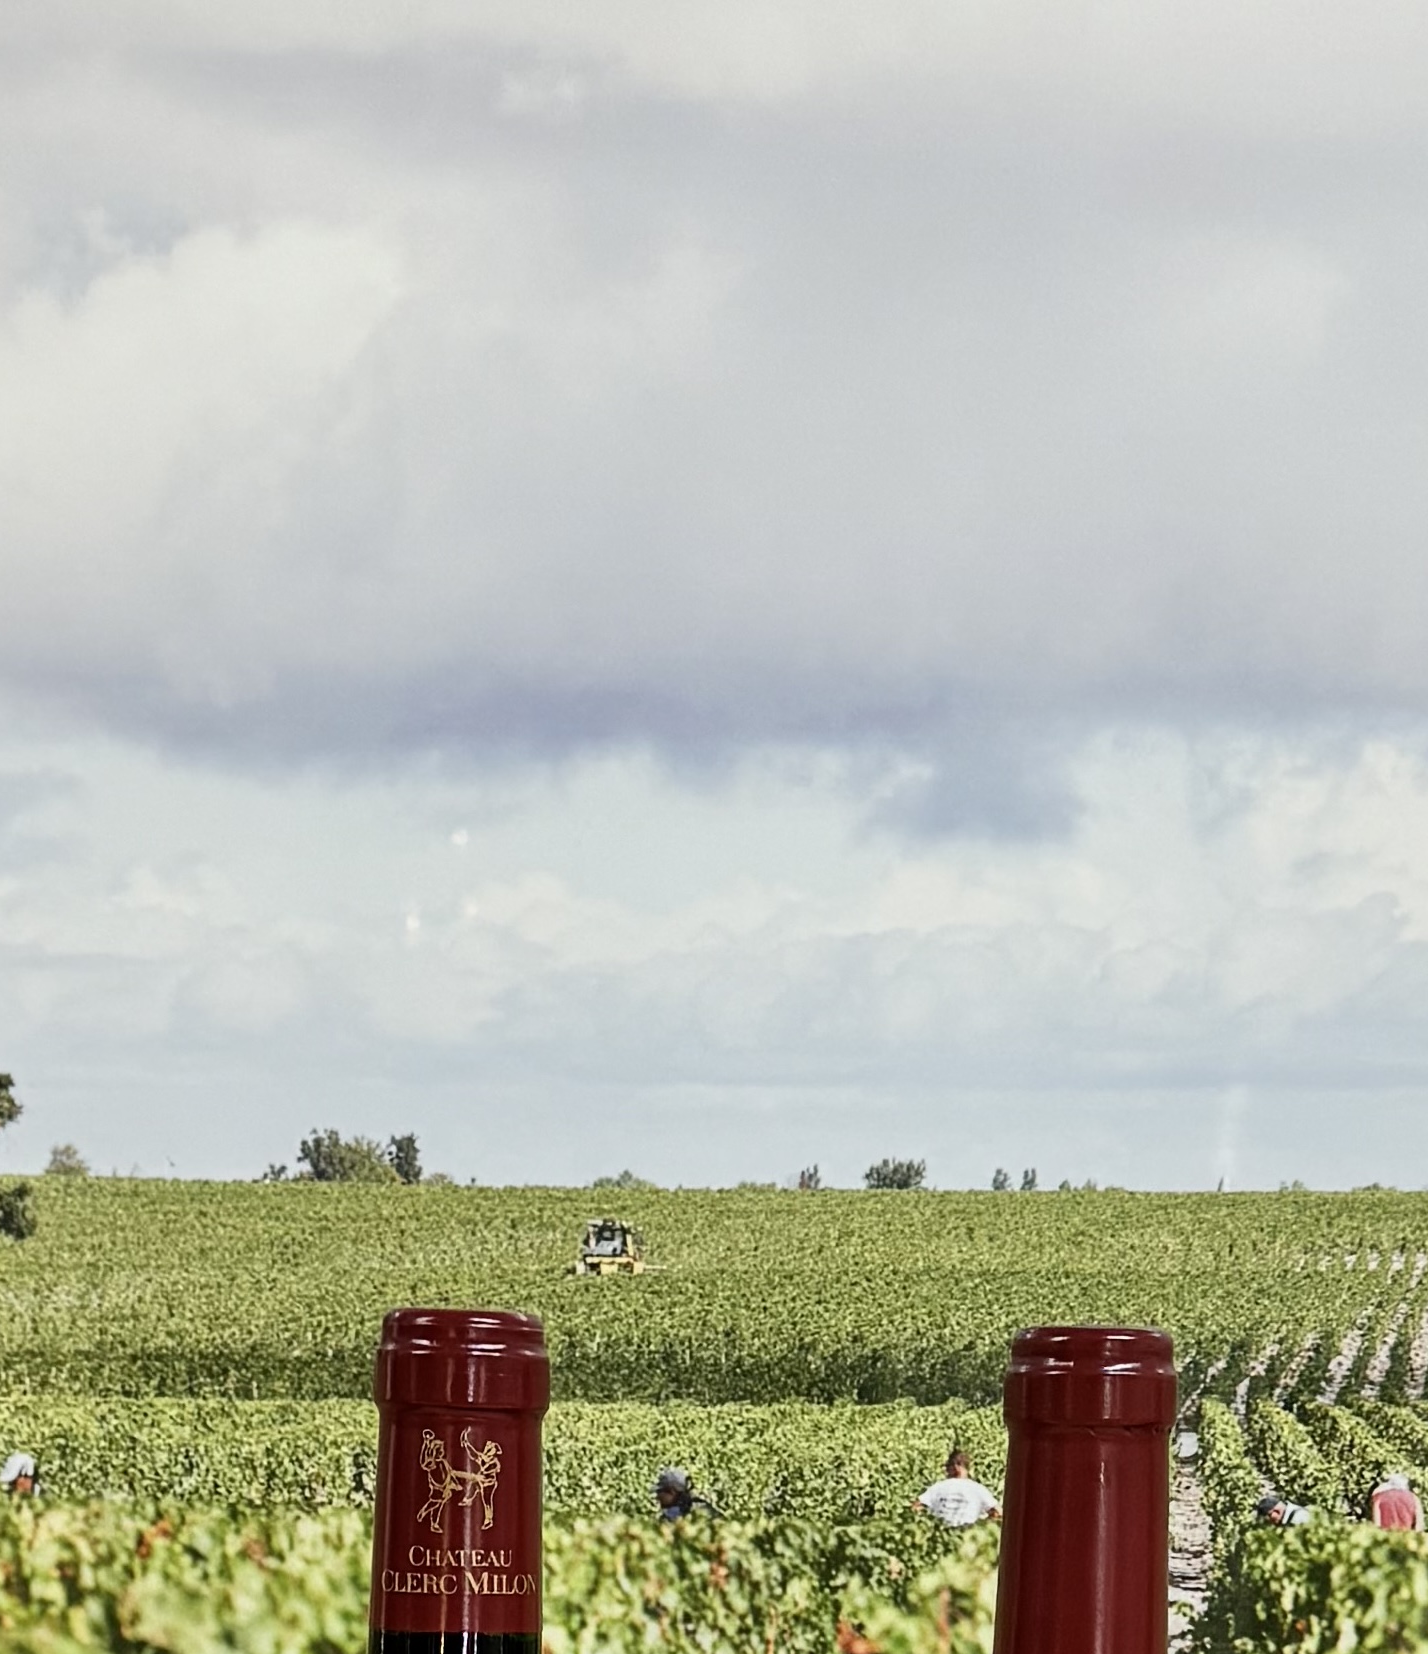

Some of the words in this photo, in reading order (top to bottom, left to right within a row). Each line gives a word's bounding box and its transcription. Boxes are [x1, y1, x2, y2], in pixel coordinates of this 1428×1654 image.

[408, 1544, 512, 1568] CHATEAU
[381, 1568, 457, 1595] CLERC
[464, 1571, 536, 1595] MILON
